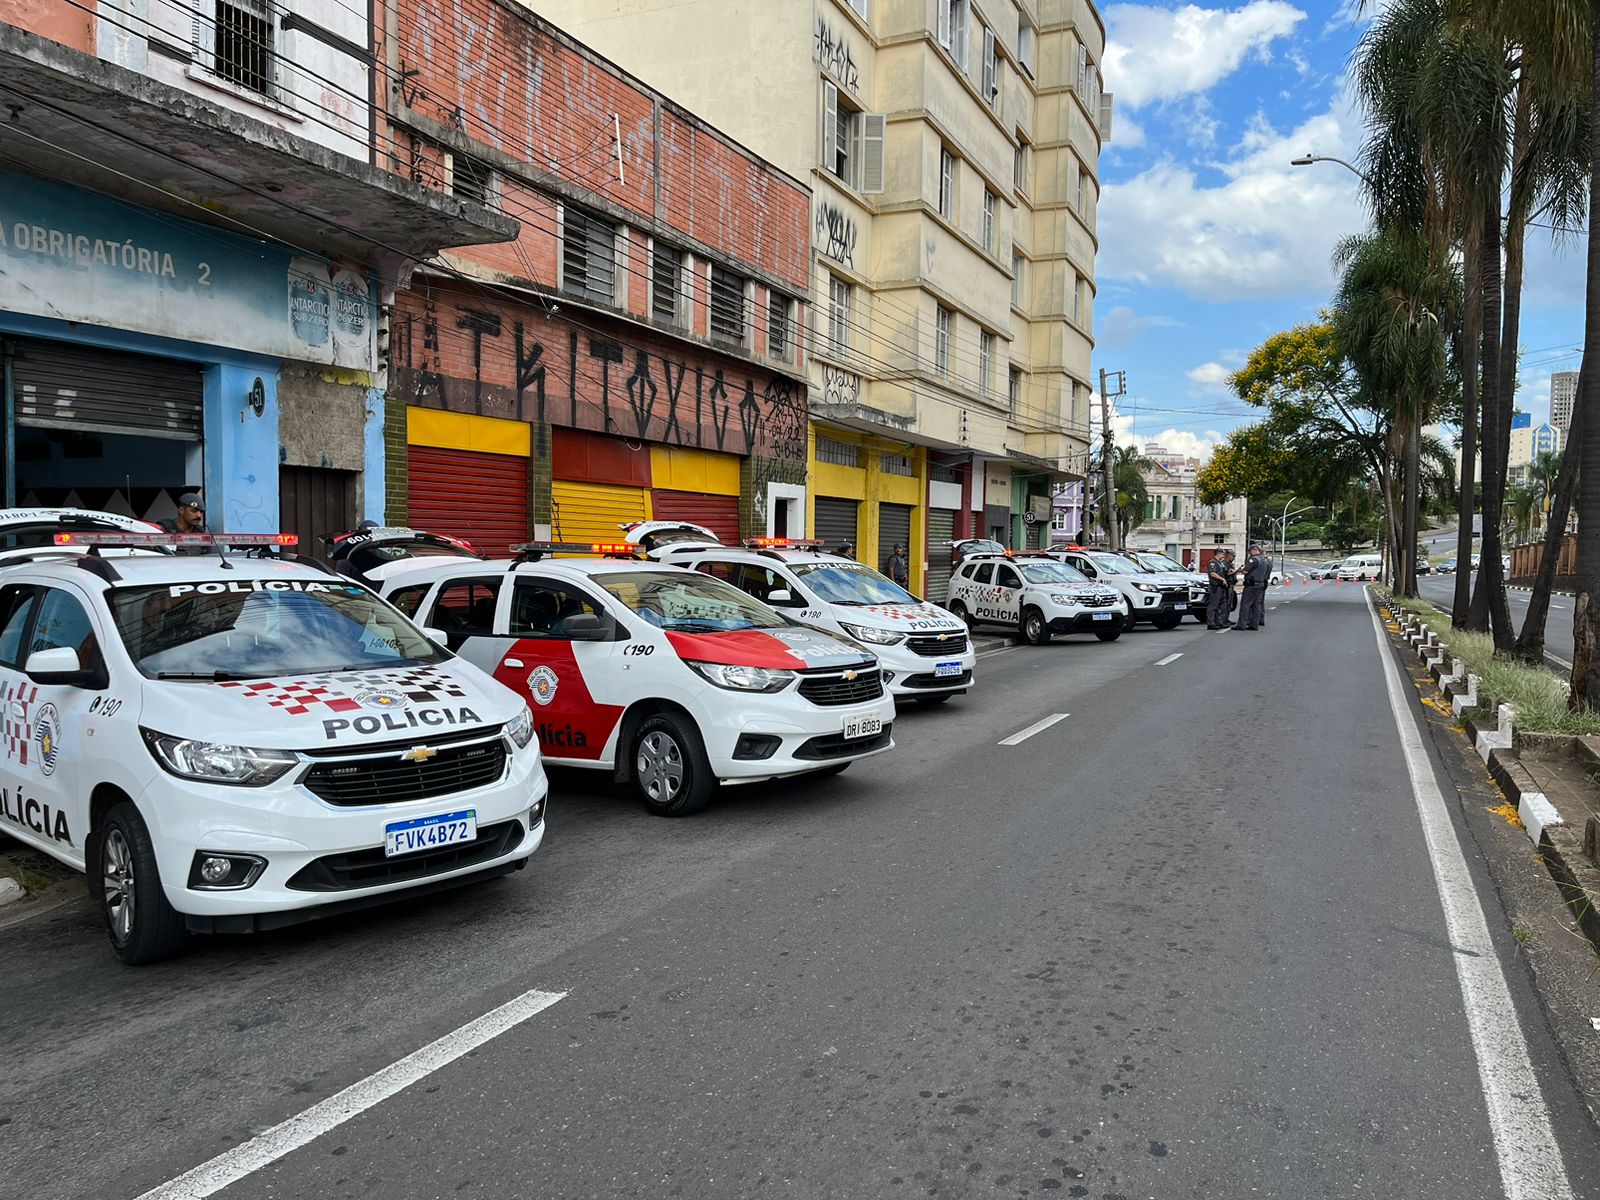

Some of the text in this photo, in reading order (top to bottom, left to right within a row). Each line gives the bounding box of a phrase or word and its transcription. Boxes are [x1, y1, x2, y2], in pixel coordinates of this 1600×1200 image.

[14, 222, 176, 278] OBRIGATÓRIA
[198, 262, 211, 285] 2
[254, 387, 263, 408] 51
[1026, 513, 1034, 521] 51
[808, 562, 862, 571] POLÍCIA
[169, 579, 330, 598] POLÍCIA
[808, 610, 822, 619] 190
[975, 606, 1019, 622] POLÍCIA
[909, 620, 959, 631] POLÍCIA
[631, 644, 655, 656] 190
[98, 699, 122, 717] 190
[322, 707, 483, 740] POLÍCIA
[540, 722, 588, 748] lícia
[0, 785, 75, 848] LÍCIA
[395, 821, 468, 852] FVK4B72
